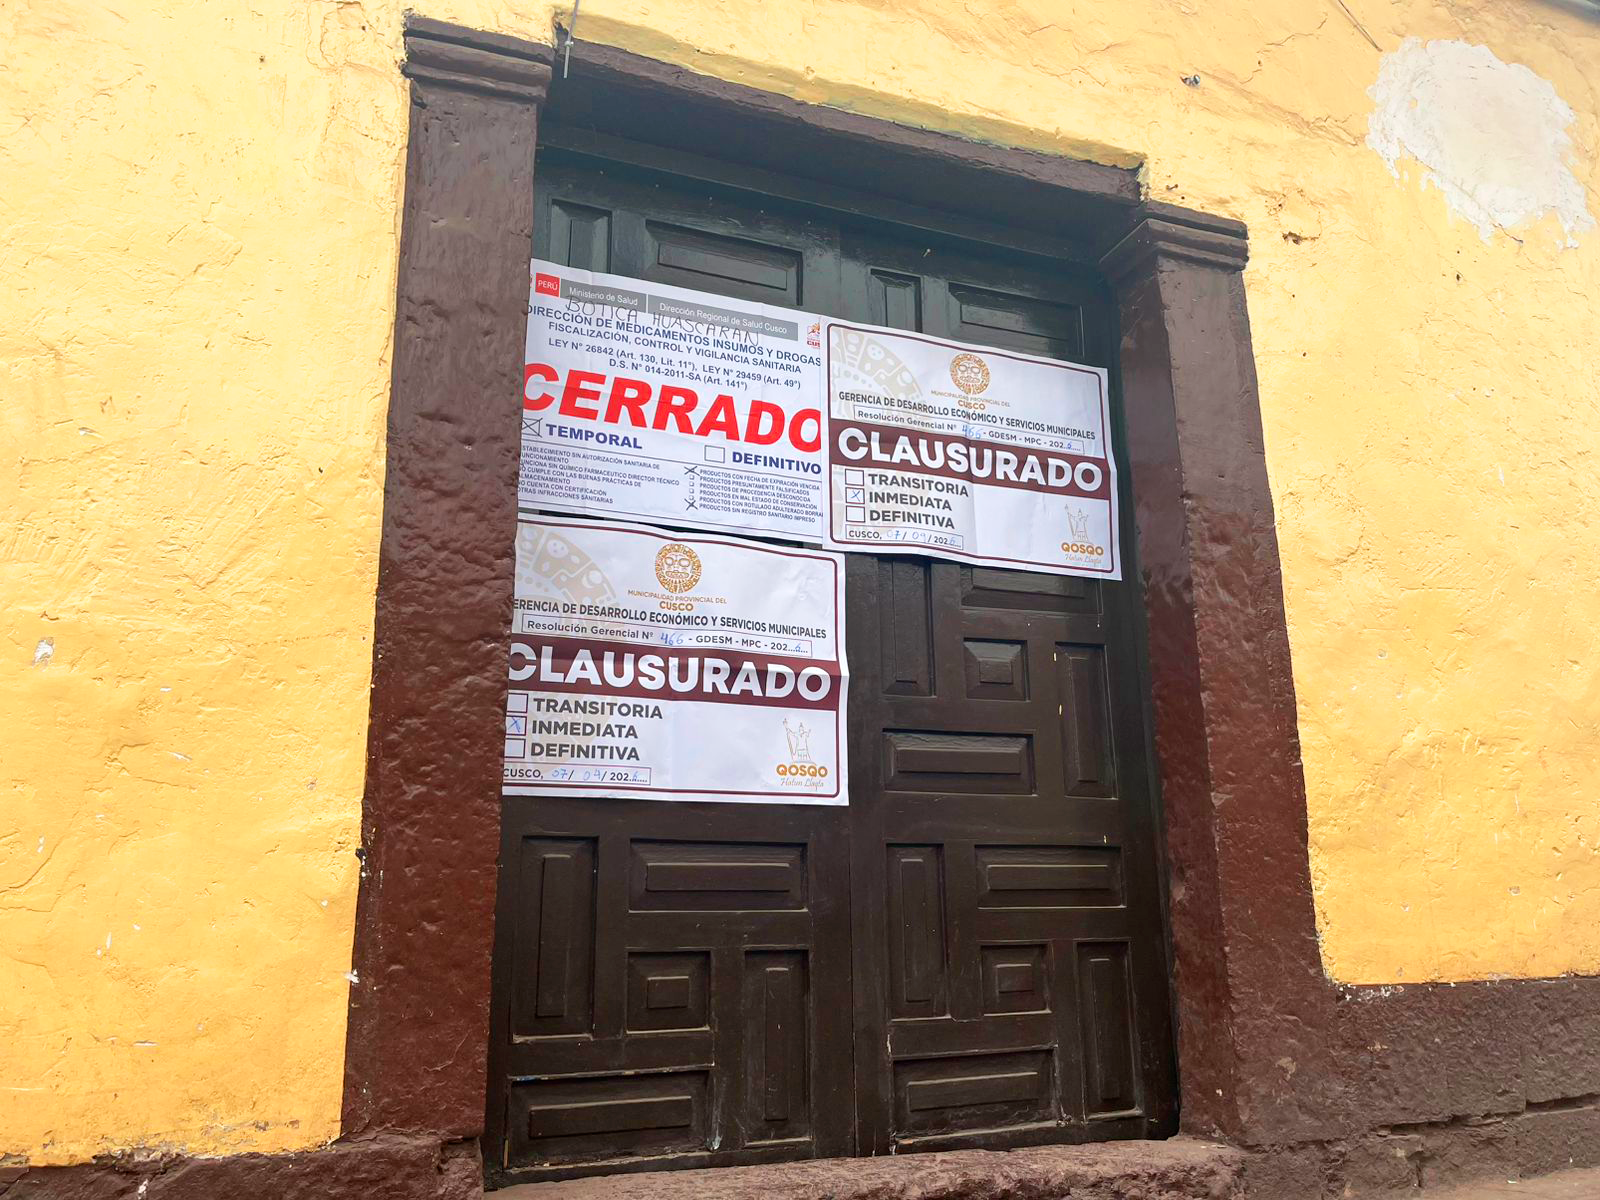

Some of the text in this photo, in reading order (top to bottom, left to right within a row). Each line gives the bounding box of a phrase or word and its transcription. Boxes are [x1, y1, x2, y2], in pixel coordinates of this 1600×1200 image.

[538, 279, 558, 291] PERÚ
[569, 287, 638, 305] Ministerio de Salud
[566, 295, 638, 323] BOTICA
[660, 303, 787, 334] Dirección Regional de Salud Cusco
[549, 322, 801, 374] FISCALIZACIÓN, CONTROL Y VIGILANCIA SANITARIA
[596, 318, 612, 328] DE
[616, 321, 710, 346] MEDICAMENTOS
[713, 338, 763, 355] INSUMOS
[766, 348, 773, 358] Y
[776, 350, 821, 366] DROGAS
[549, 338, 568, 348] LEY
[586, 344, 613, 356] 26842
[616, 349, 636, 359] (Art.
[661, 357, 675, 366] Lit.
[702, 364, 720, 374] LEY
[736, 370, 761, 382] 29459
[764, 375, 781, 386] (Art.
[784, 379, 800, 390] 49°)
[609, 358, 628, 369] D.S.
[645, 365, 702, 382] 014-2011-SA
[703, 375, 723, 386] (Art.
[523, 363, 821, 453] CERRADO
[957, 399, 986, 410] CUSCO
[839, 391, 1096, 440] GERENCIA DE DESARROLLO ECONÓMICO Y SERVICIOS MUNICIPALES
[546, 423, 643, 450] TEMPORAL
[858, 410, 904, 423] Resolución
[907, 417, 945, 430] Gerencial
[989, 431, 1017, 441] GDESM
[1024, 436, 1041, 445] MPC
[521, 453, 569, 464] UNCIONAMIENTO
[522, 446, 571, 457] STABLECIMIENTO
[624, 459, 652, 469] SANITARIA
[733, 451, 822, 475] DEFINITIVO
[838, 427, 1103, 492] CLAUSURADO
[520, 459, 547, 467] UNCIONA
[628, 474, 655, 482] DIRECTOR
[520, 473, 570, 484] LMACENAMIENTO
[527, 466, 551, 475] CUMPLE
[578, 474, 600, 482] BUENAS
[700, 469, 731, 478] PRODUCTOS
[700, 476, 731, 485] PRODUCTOS
[527, 480, 550, 489] CUENTA
[538, 489, 579, 500] INFRACCIONES
[700, 483, 731, 492] PRODUCTOS
[700, 490, 731, 499] PRODUCTOS
[868, 473, 968, 498] TRANSITORIA
[699, 503, 731, 512] PRODUCTOS
[700, 496, 731, 506] PRODUCTOS
[869, 491, 952, 511] INMEDIATA
[869, 509, 955, 530] DEFINITIVA
[849, 530, 882, 540] CUSCO,
[1061, 542, 1104, 556] QOSQO
[628, 589, 674, 601] MUNICIPALIDAD
[675, 595, 714, 603] PROVINCIAL
[659, 600, 694, 611] CUSCO
[513, 599, 827, 639] ERENCIA DE DESARROLLO ECONÓMICO Y SERVICIOS MUNICIPALES
[527, 620, 588, 633] Resolución
[591, 626, 639, 639] Gerencial
[660, 632, 684, 646] 466
[696, 635, 732, 645] GDESM
[741, 638, 761, 648] MPC
[509, 642, 831, 702] CLAUSURADO
[533, 697, 663, 720] TRANSITORIA
[531, 720, 638, 740] INMEDIATA
[530, 742, 641, 762] DEFINITIVA
[503, 768, 544, 779] CUSCO,
[776, 764, 828, 778] QOSQO
